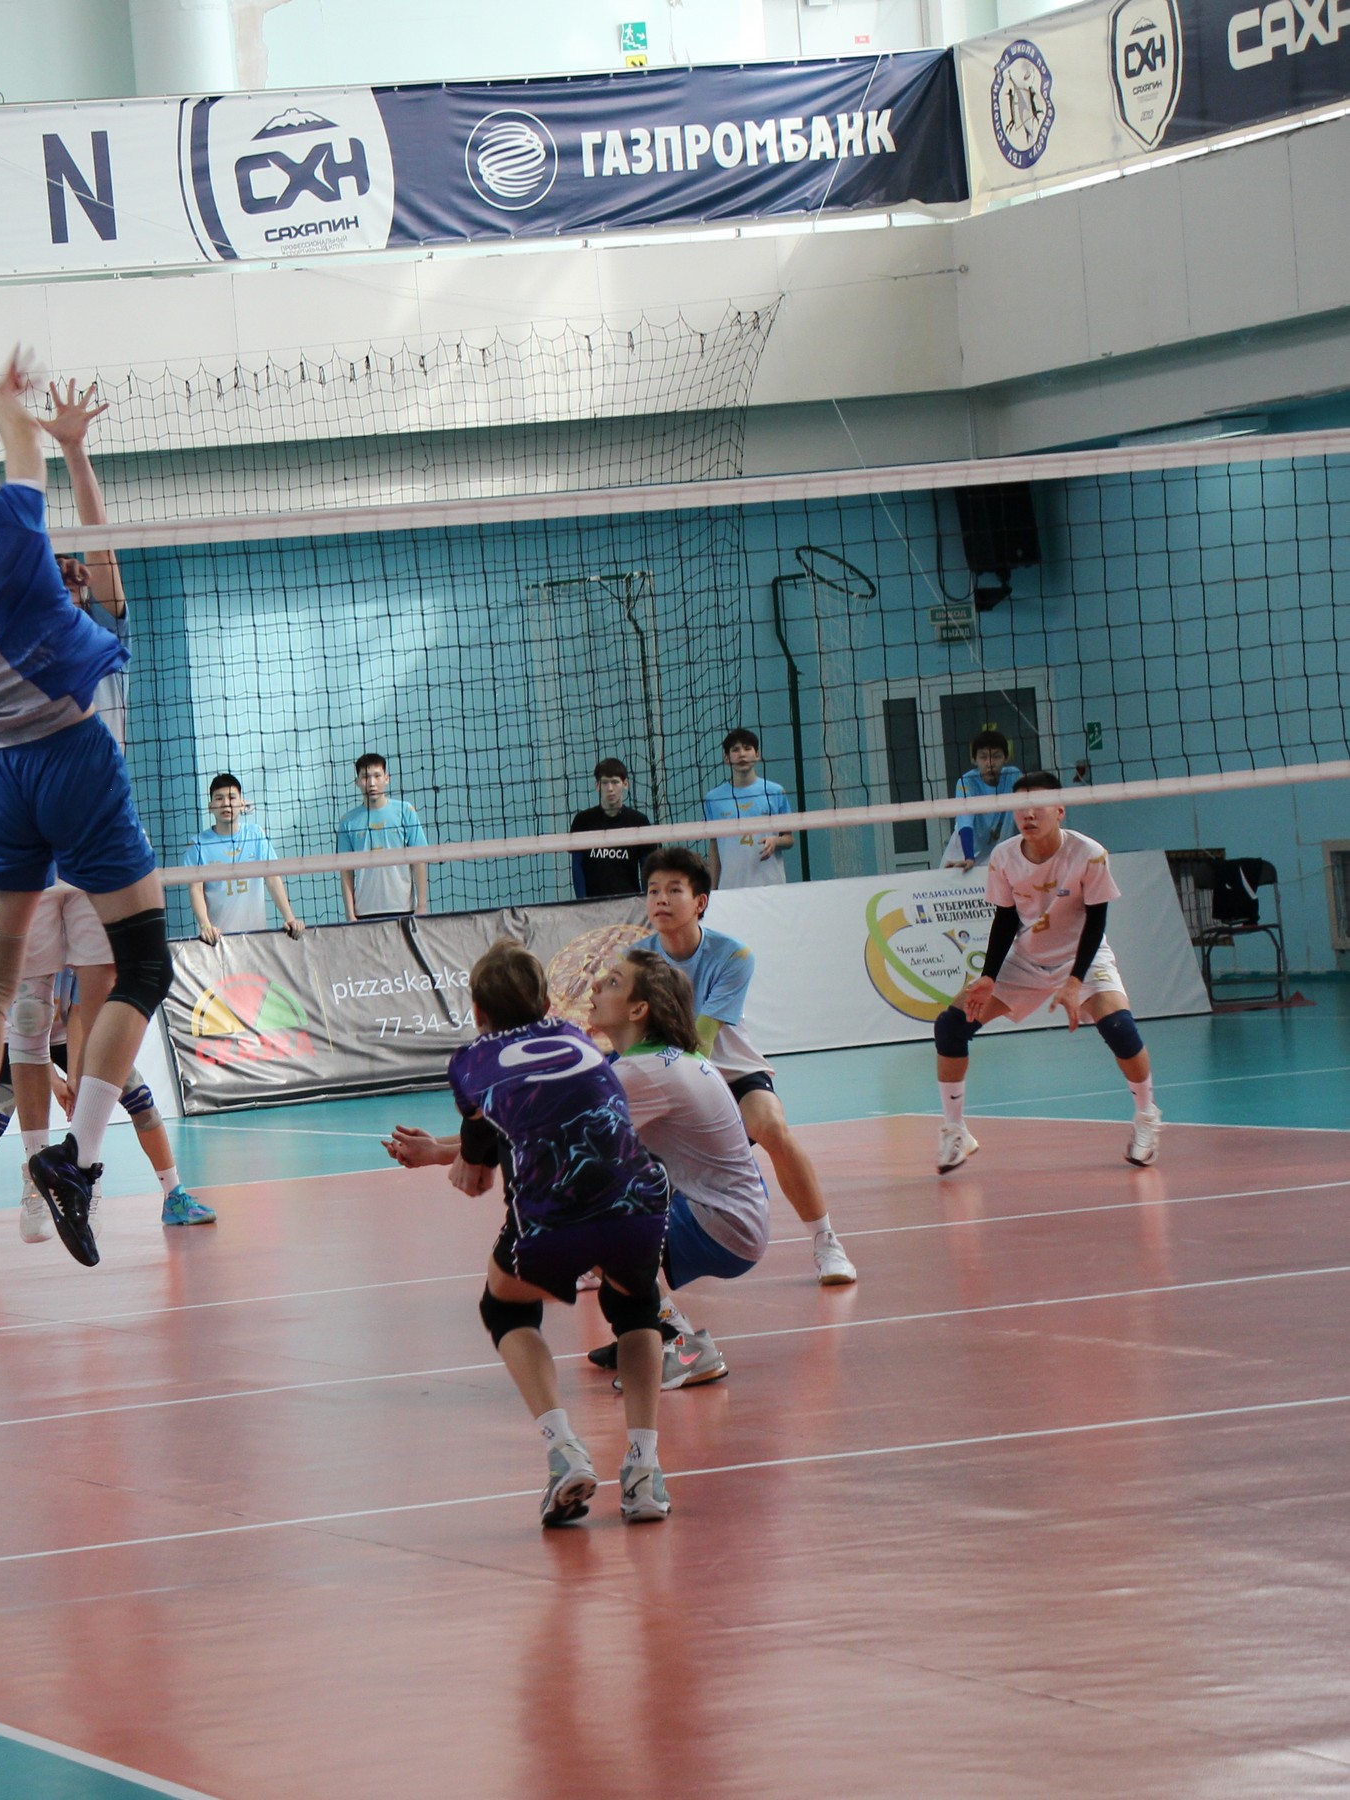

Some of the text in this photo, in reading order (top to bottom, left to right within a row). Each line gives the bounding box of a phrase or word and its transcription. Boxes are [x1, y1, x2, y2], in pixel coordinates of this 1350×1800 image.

[581, 108, 896, 177] ГАЗПРОМБАНК
[897, 944, 929, 956] Читай!
[922, 966, 962, 979] Смотри!
[498, 1035, 604, 1082] 9
